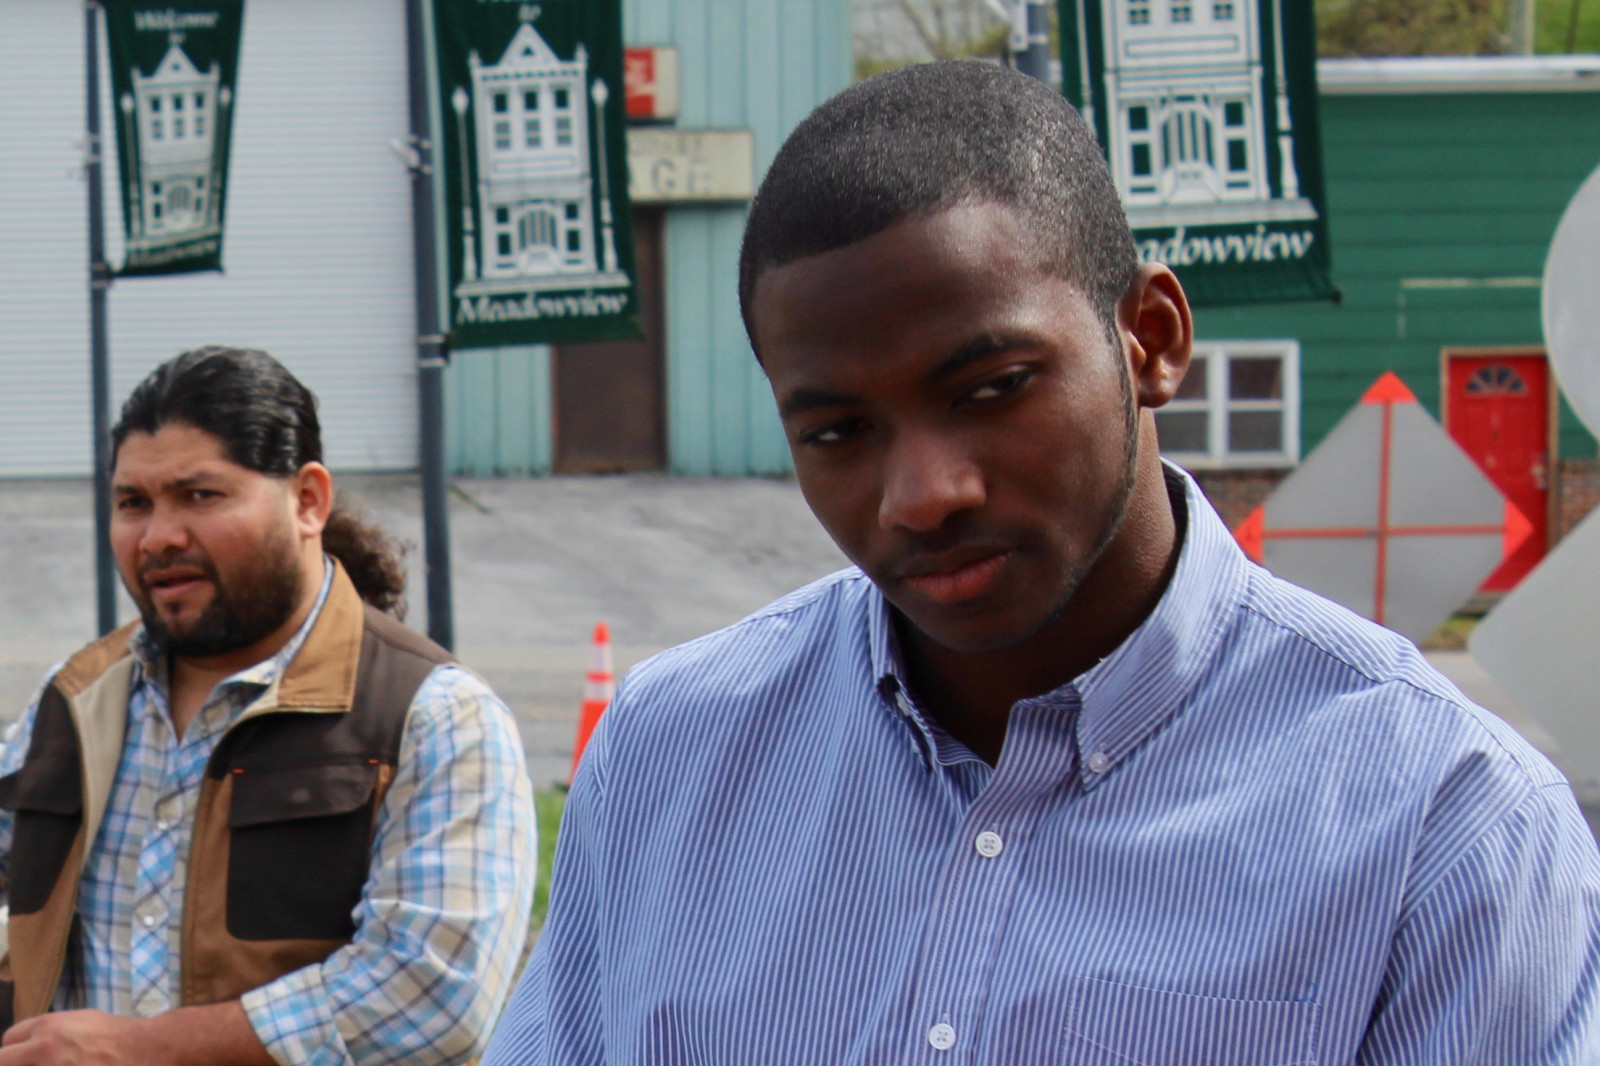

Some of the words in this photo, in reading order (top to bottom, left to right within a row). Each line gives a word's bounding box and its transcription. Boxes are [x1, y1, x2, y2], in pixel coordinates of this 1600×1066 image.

[518, 3, 542, 21] to
[1137, 223, 1314, 266] adowview
[456, 289, 628, 325] Meadowview
